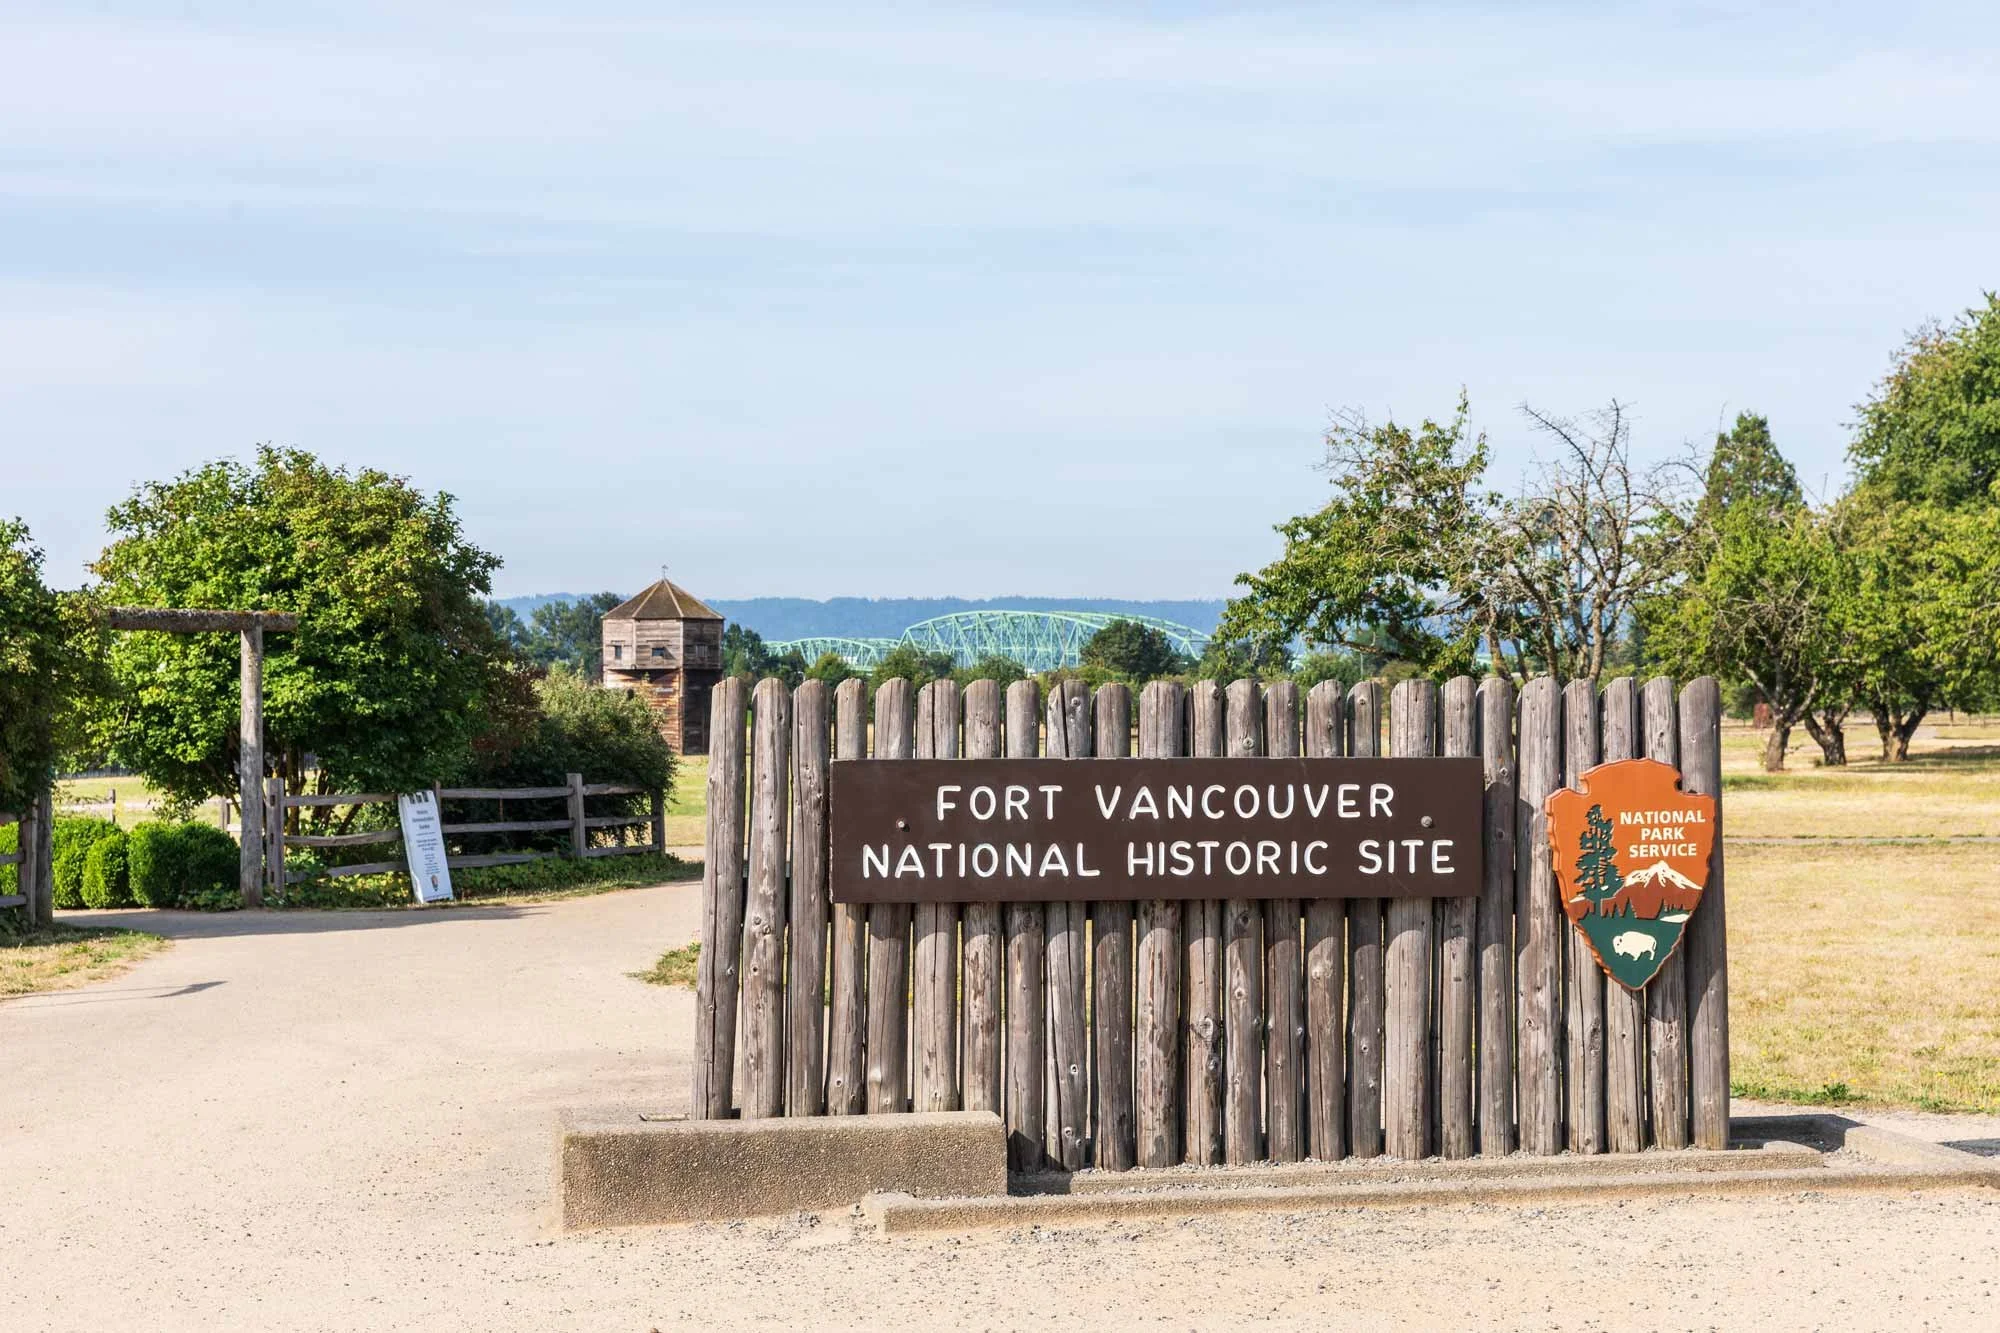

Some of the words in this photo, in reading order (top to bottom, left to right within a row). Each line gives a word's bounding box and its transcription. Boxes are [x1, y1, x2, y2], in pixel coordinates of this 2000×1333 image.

[936, 784, 1063, 821] FORT
[1094, 783, 1395, 820] VANCOUVER
[1620, 810, 1706, 825] NATIONAL
[1641, 826, 1685, 841] PARK
[1629, 843, 1697, 858] SERVICE
[862, 842, 1101, 879] NATIONAL
[1127, 840, 1329, 877] HISTORIC
[1358, 839, 1455, 875] SITE
